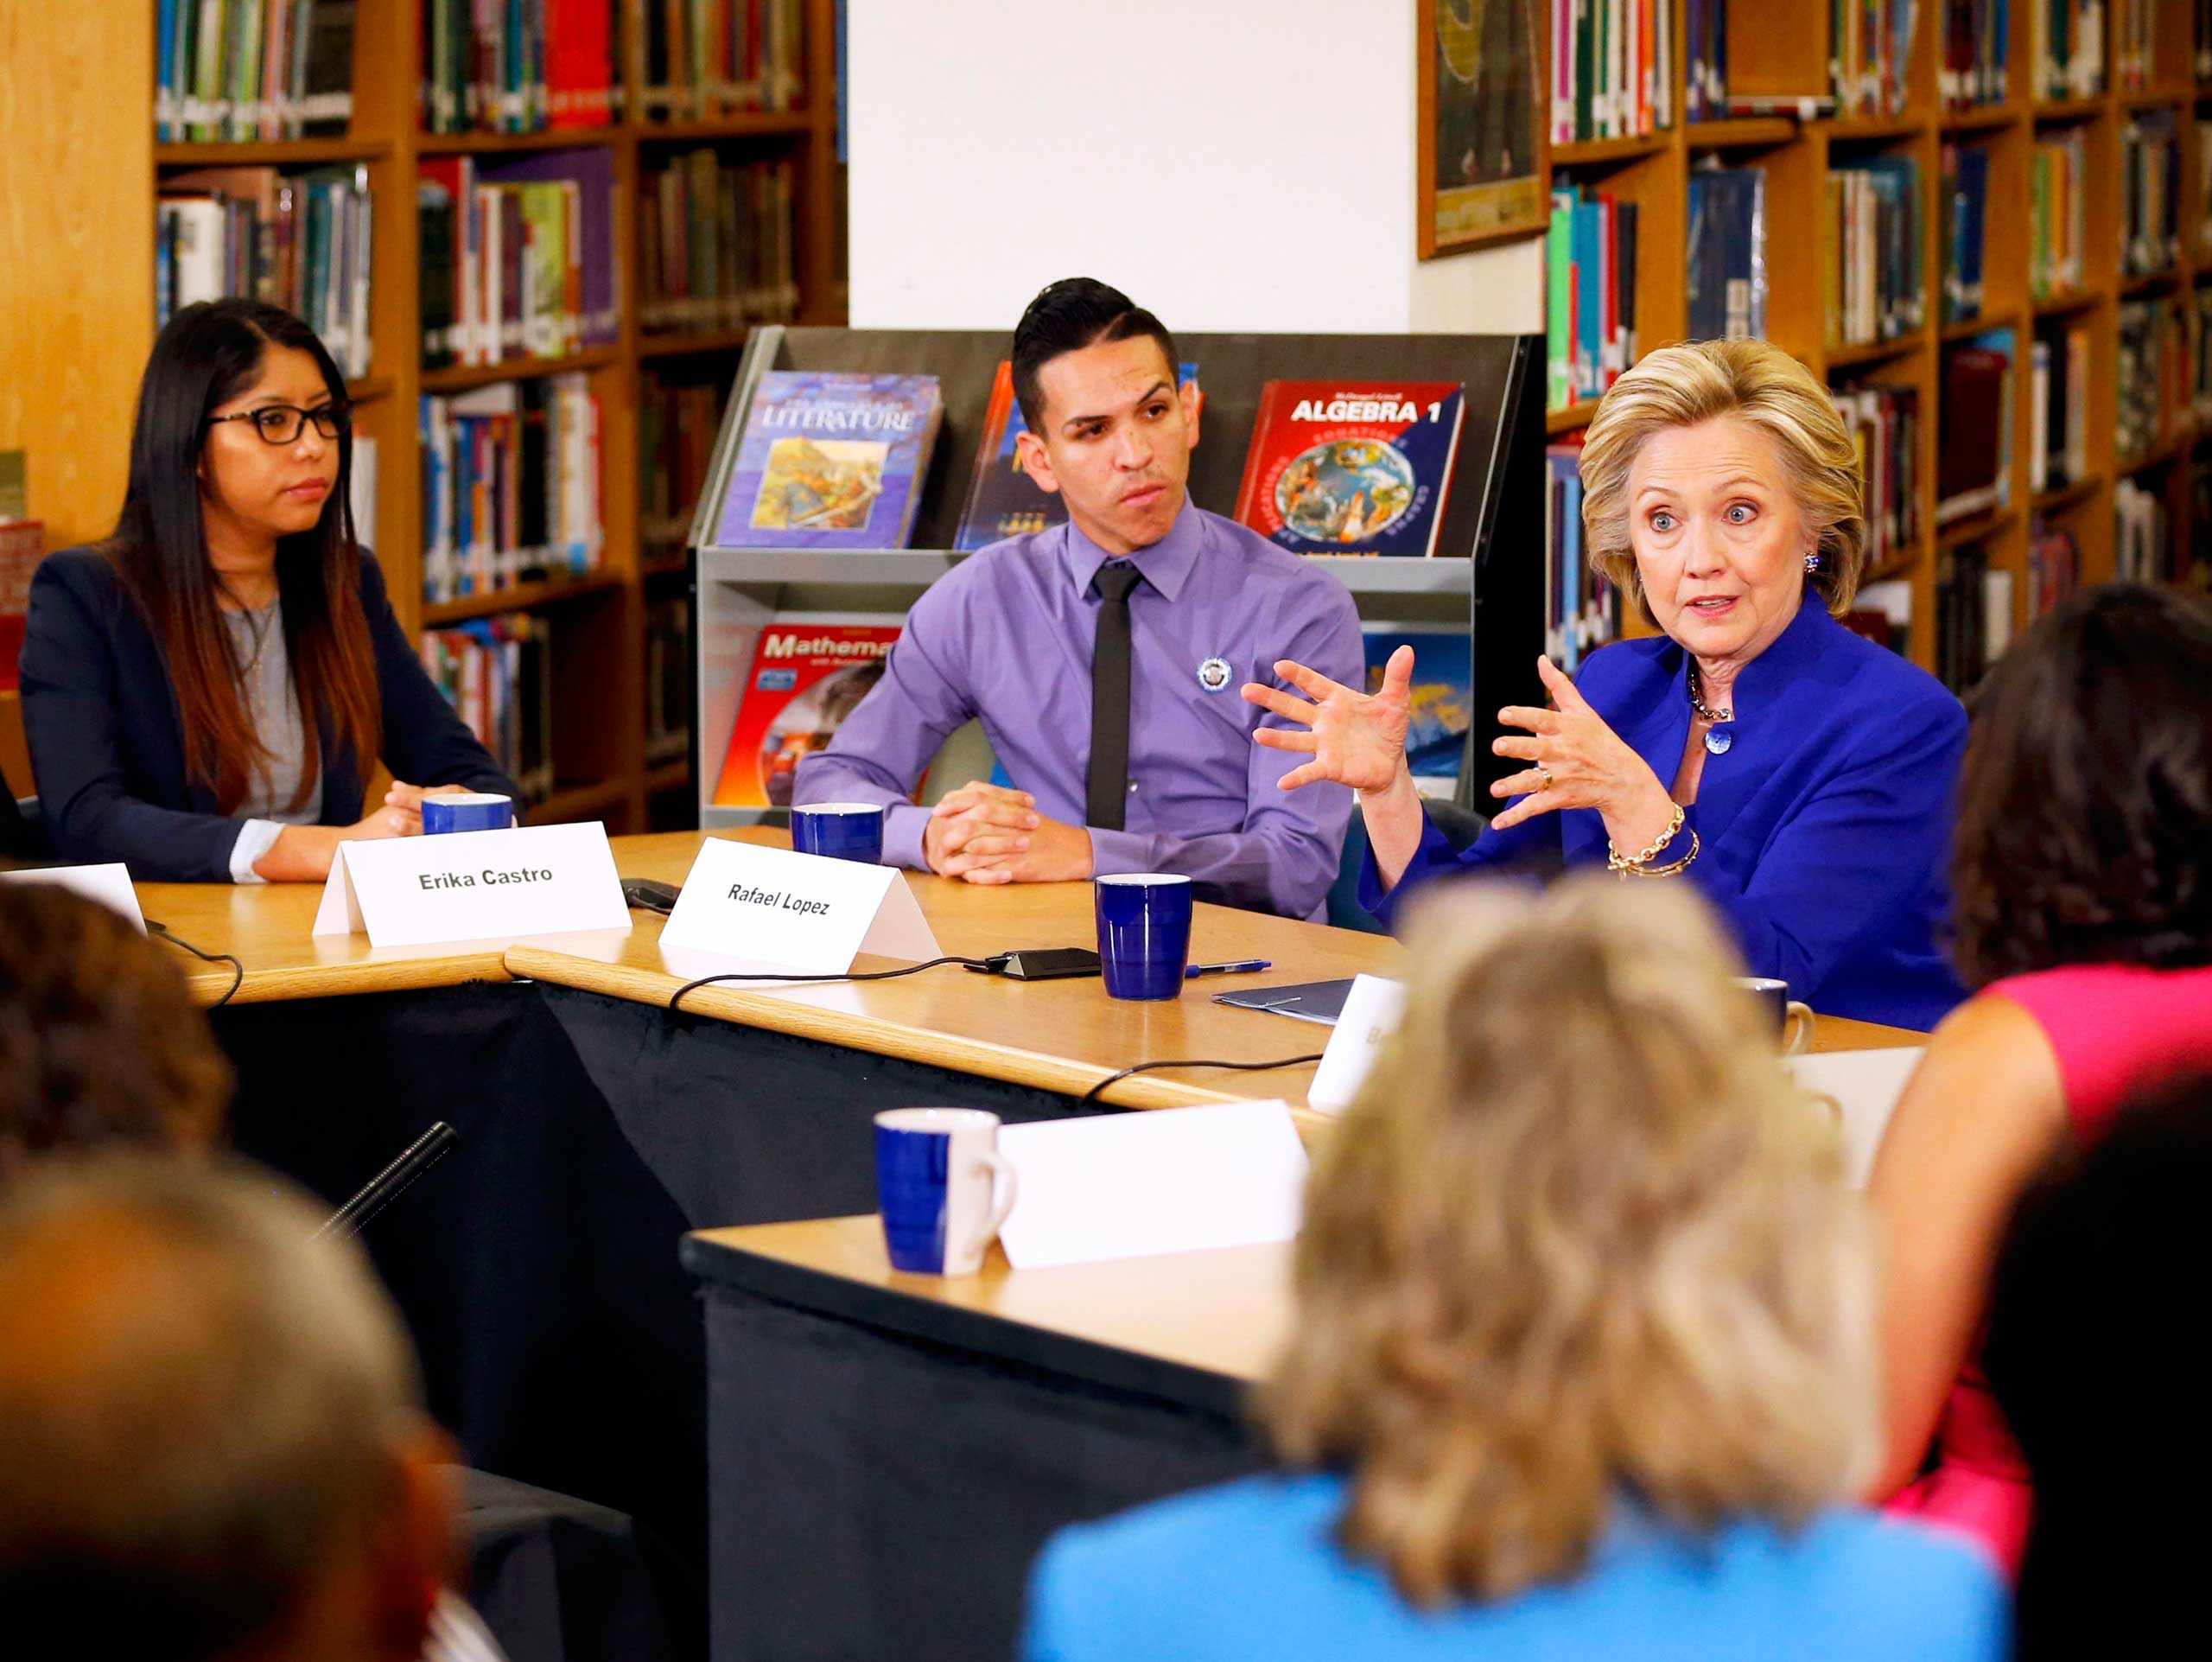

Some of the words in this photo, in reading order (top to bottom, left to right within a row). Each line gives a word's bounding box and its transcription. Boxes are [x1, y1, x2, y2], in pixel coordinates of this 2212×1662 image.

[762, 404, 916, 431] LITERATURE
[1291, 400, 1418, 423] ALGEBRA
[1427, 402, 1441, 423] 1
[419, 873, 475, 890] Erika
[482, 868, 553, 885] Castro
[728, 883, 781, 907] Rafael
[782, 893, 830, 915] Lopez
